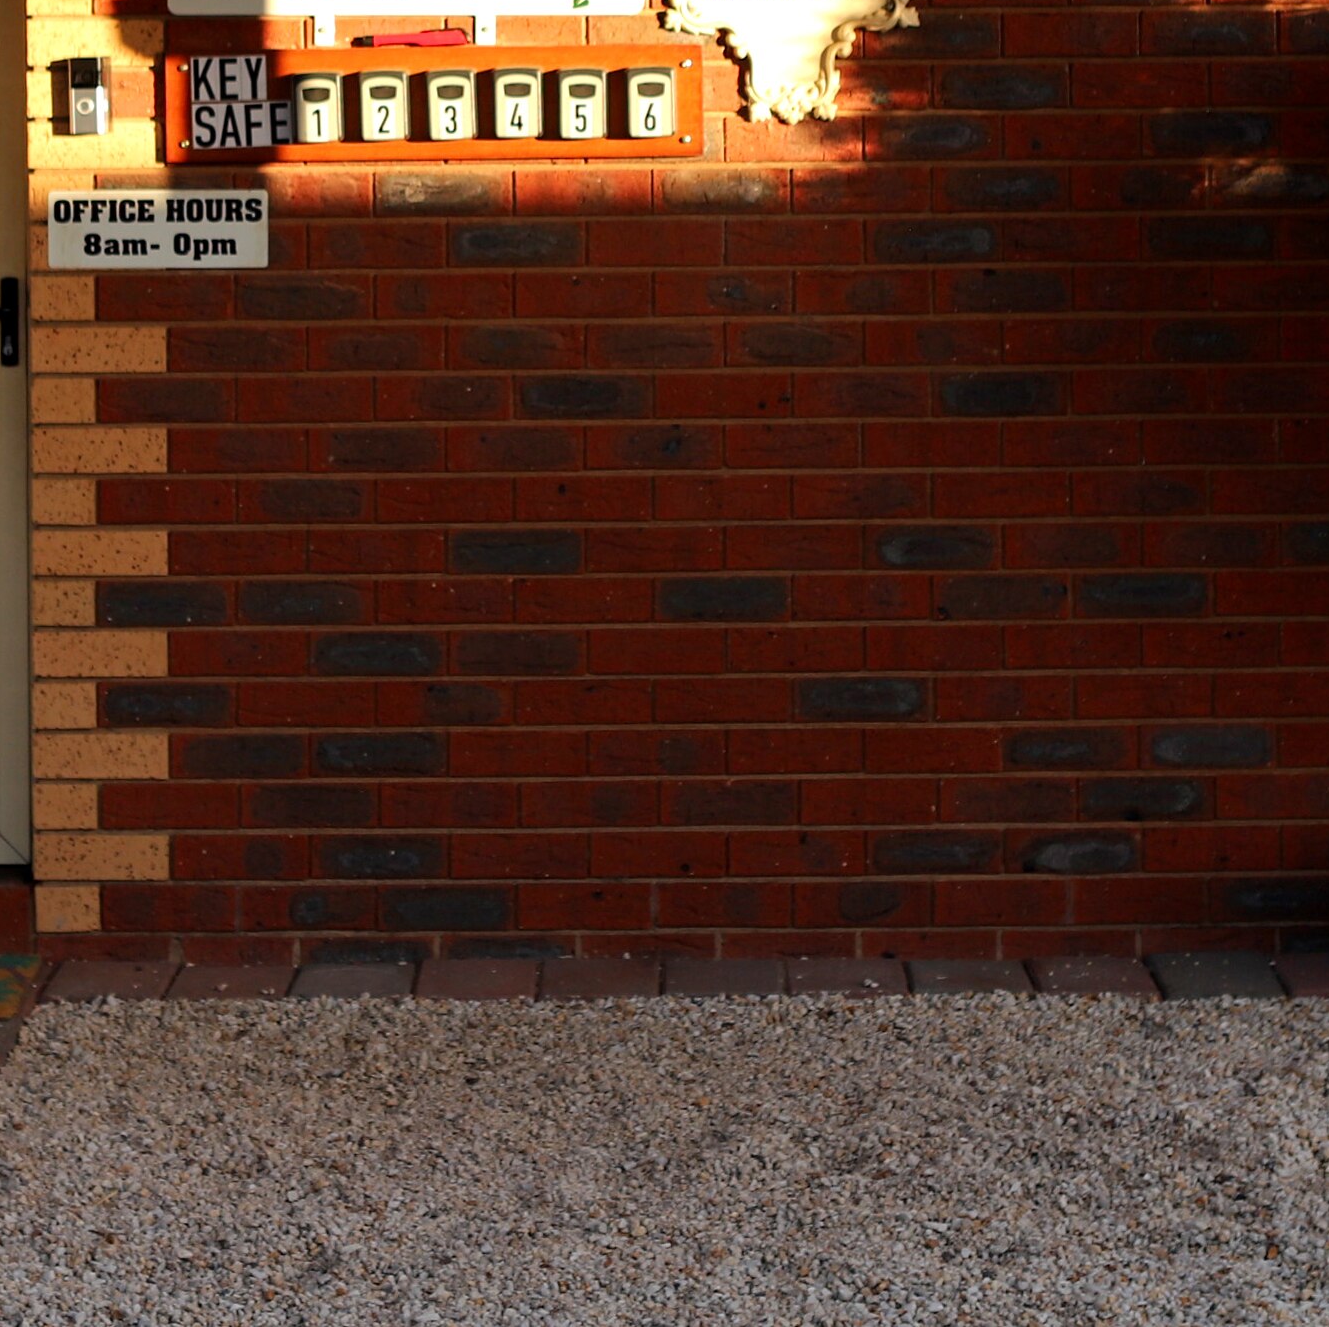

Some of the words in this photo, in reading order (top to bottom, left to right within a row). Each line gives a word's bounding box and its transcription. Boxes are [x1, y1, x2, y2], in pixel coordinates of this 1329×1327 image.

[192, 57, 264, 102] KEY
[193, 104, 291, 148] SAFE
[310, 109, 322, 137] 1
[378, 108, 391, 135] 2
[444, 108, 458, 135] 3
[509, 105, 524, 133] 4
[574, 106, 588, 133] 5
[644, 104, 658, 132] 6
[53, 199, 155, 223] OFFICE
[166, 198, 263, 222] HOURS
